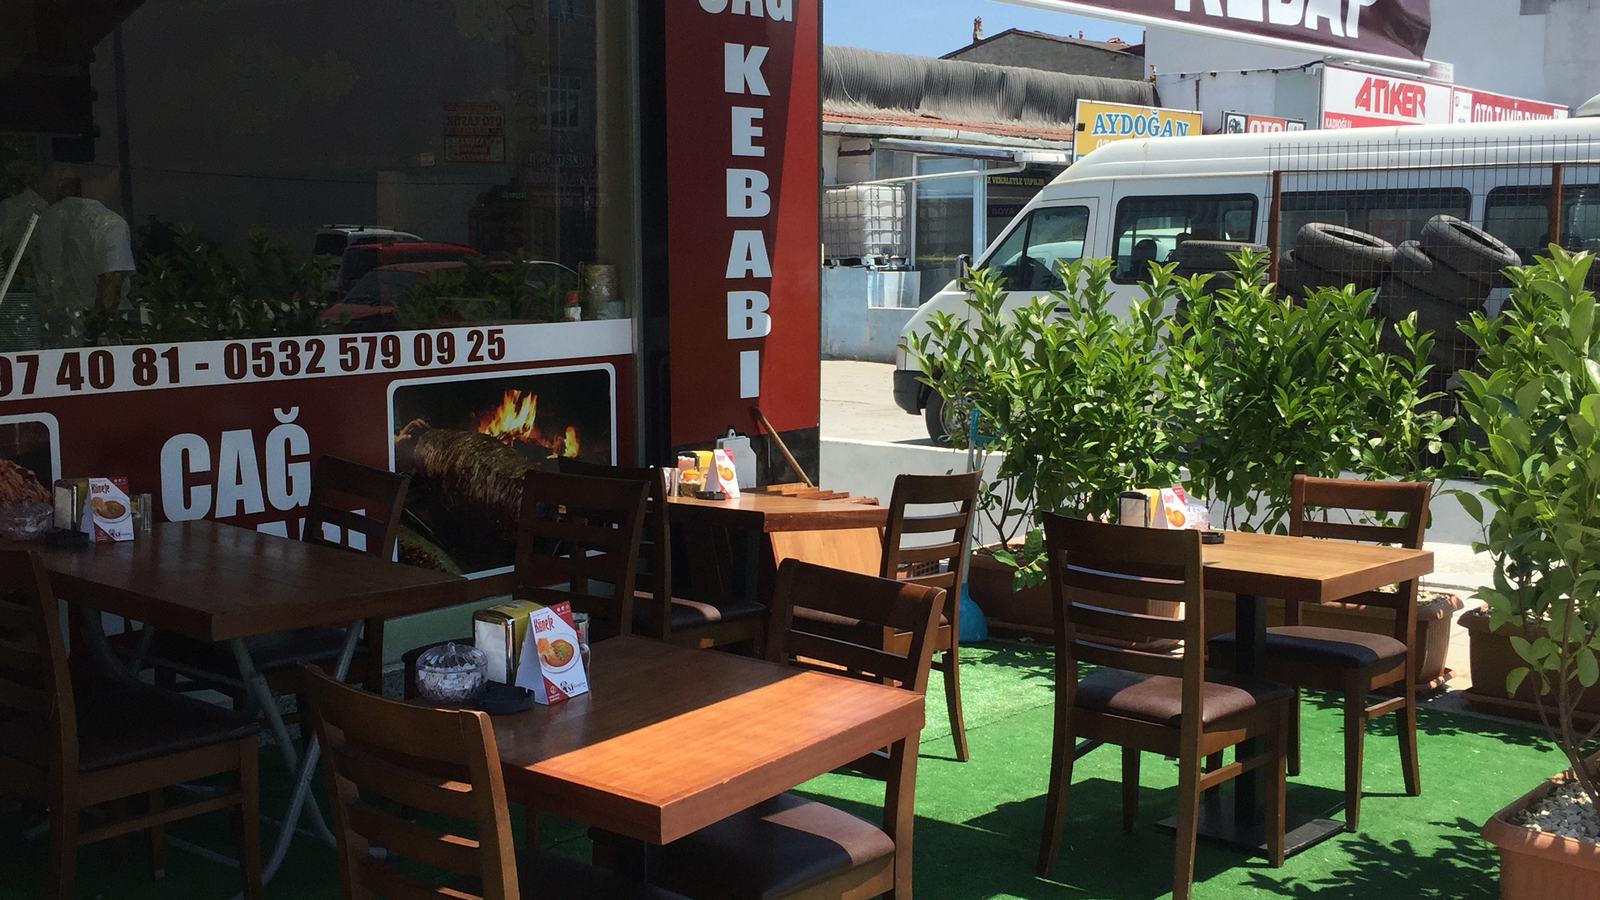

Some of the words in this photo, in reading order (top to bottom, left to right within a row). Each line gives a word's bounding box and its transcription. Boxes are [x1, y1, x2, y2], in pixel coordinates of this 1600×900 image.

[1091, 109, 1189, 137] AYDOĞAN
[724, 42, 772, 399] KEBABI
[56, 349, 115, 391] 40
[132, 346, 180, 387] 81
[223, 338, 326, 380] 0532
[338, 334, 401, 372] 579
[413, 331, 456, 366] 09
[466, 328, 506, 363] 25
